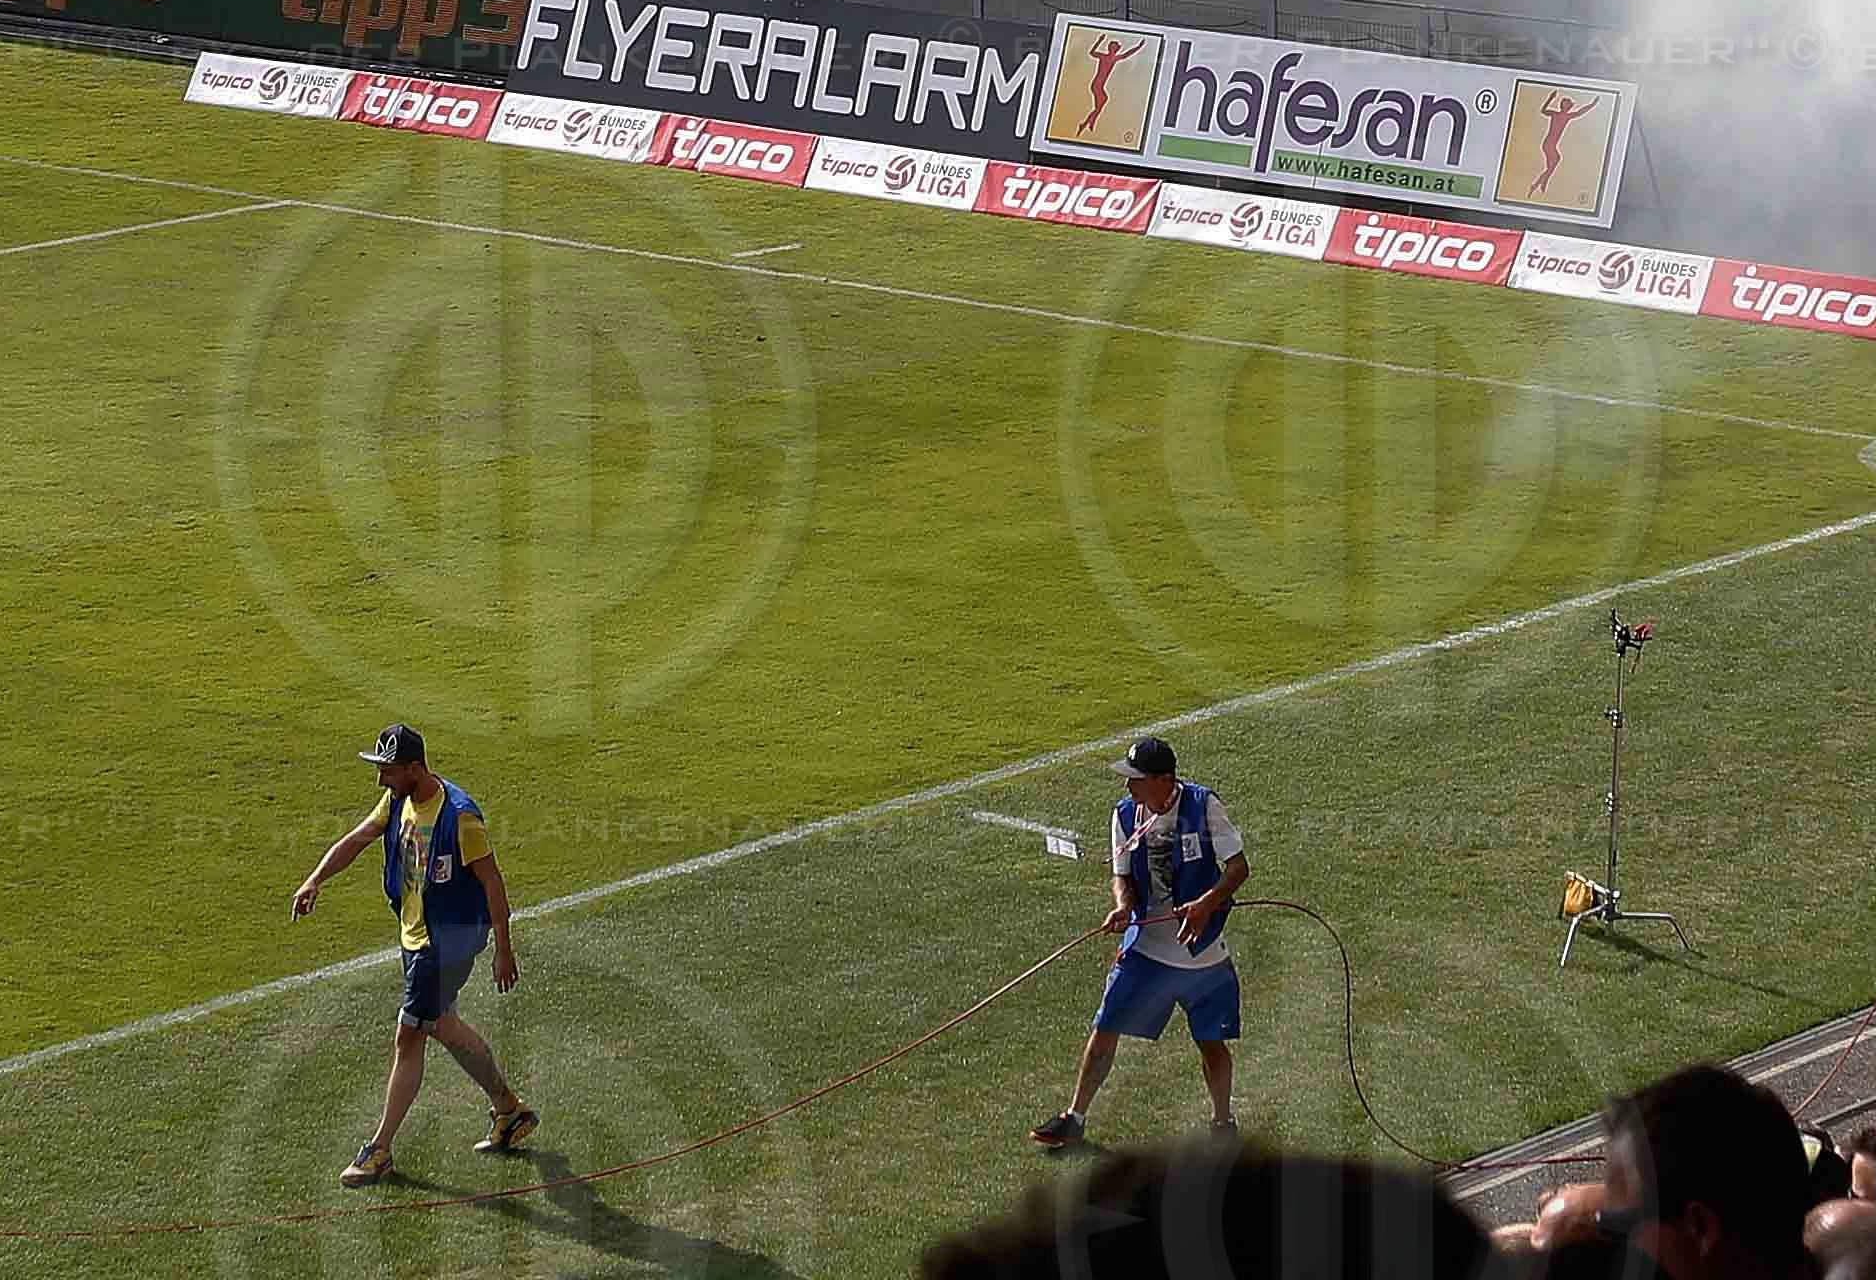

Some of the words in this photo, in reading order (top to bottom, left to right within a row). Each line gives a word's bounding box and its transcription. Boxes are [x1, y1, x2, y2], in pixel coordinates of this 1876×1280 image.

[200, 67, 254, 91] tipico
[293, 72, 338, 89] BUNDES
[289, 85, 334, 107] LIGA
[362, 75, 480, 130] tipico
[1163, 39, 1469, 173] hafesan
[503, 106, 558, 132] tipico
[598, 114, 647, 132] BUNDES
[592, 127, 642, 150] LIGA
[671, 119, 795, 175] tipico
[820, 152, 879, 179] tipico
[922, 161, 973, 181] BUNDES
[1276, 152, 1456, 194] www.hafesan.at
[915, 175, 967, 200] LIGA
[1001, 167, 1134, 220] tipico
[1161, 200, 1223, 227] tipico
[1270, 208, 1323, 228] BUNDES
[1264, 222, 1317, 248] LIGA
[1352, 213, 1495, 271] tipico
[1526, 249, 1589, 277] tipico
[1640, 258, 1698, 278] BUNDES
[1634, 273, 1692, 300] LIGA
